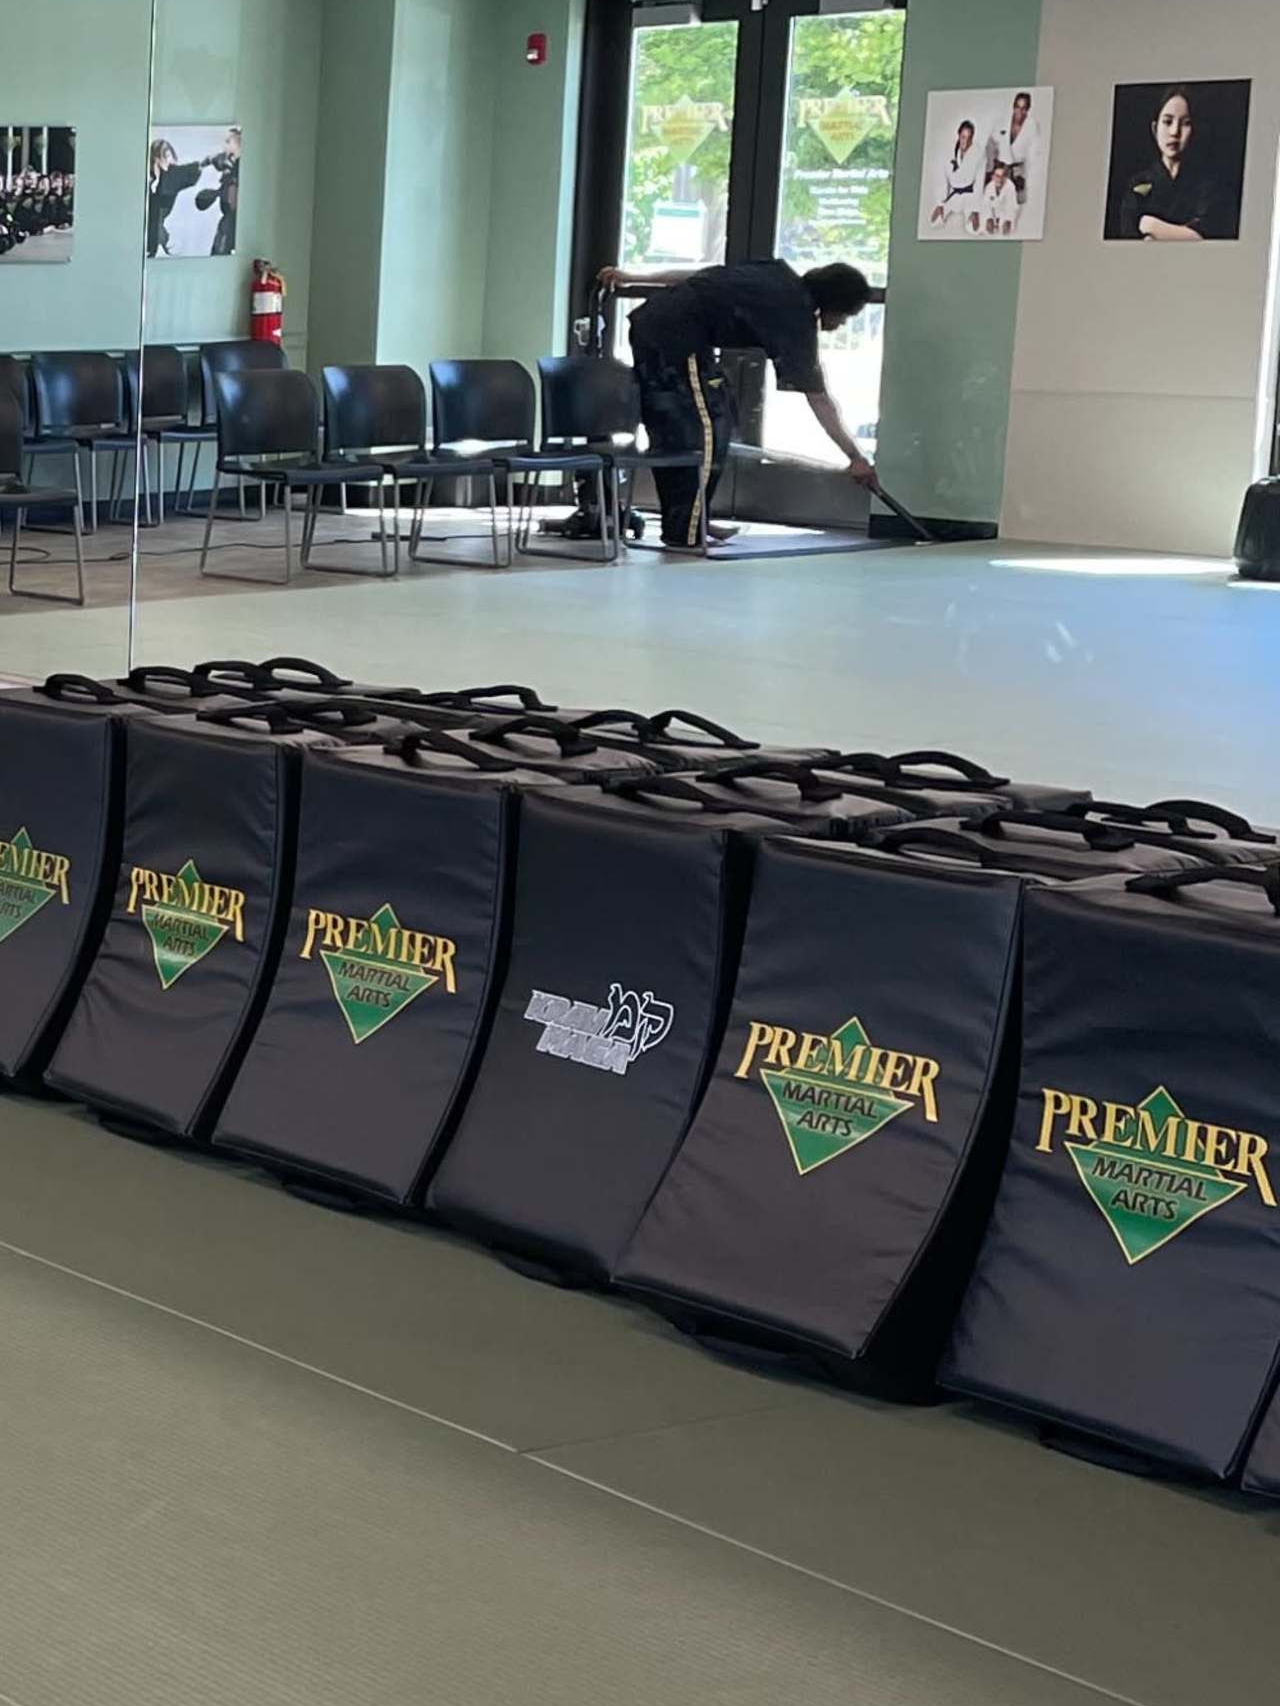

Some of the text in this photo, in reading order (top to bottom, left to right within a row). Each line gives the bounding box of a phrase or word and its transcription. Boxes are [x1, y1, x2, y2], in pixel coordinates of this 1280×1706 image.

[126, 866, 246, 943] PREMIER
[153, 913, 210, 941] MARTIAL
[299, 909, 457, 994] PREMIER
[338, 961, 411, 992] MARTIAL
[347, 985, 392, 1008] ARTS
[734, 1021, 940, 1123] PREMIER
[782, 1080, 878, 1119] MARTIAL
[796, 1109, 854, 1138] ARTS
[1035, 1087, 1279, 1208] PREMIER
[1091, 1156, 1209, 1202] MARTIAL
[1110, 1188, 1178, 1220] ARTS
